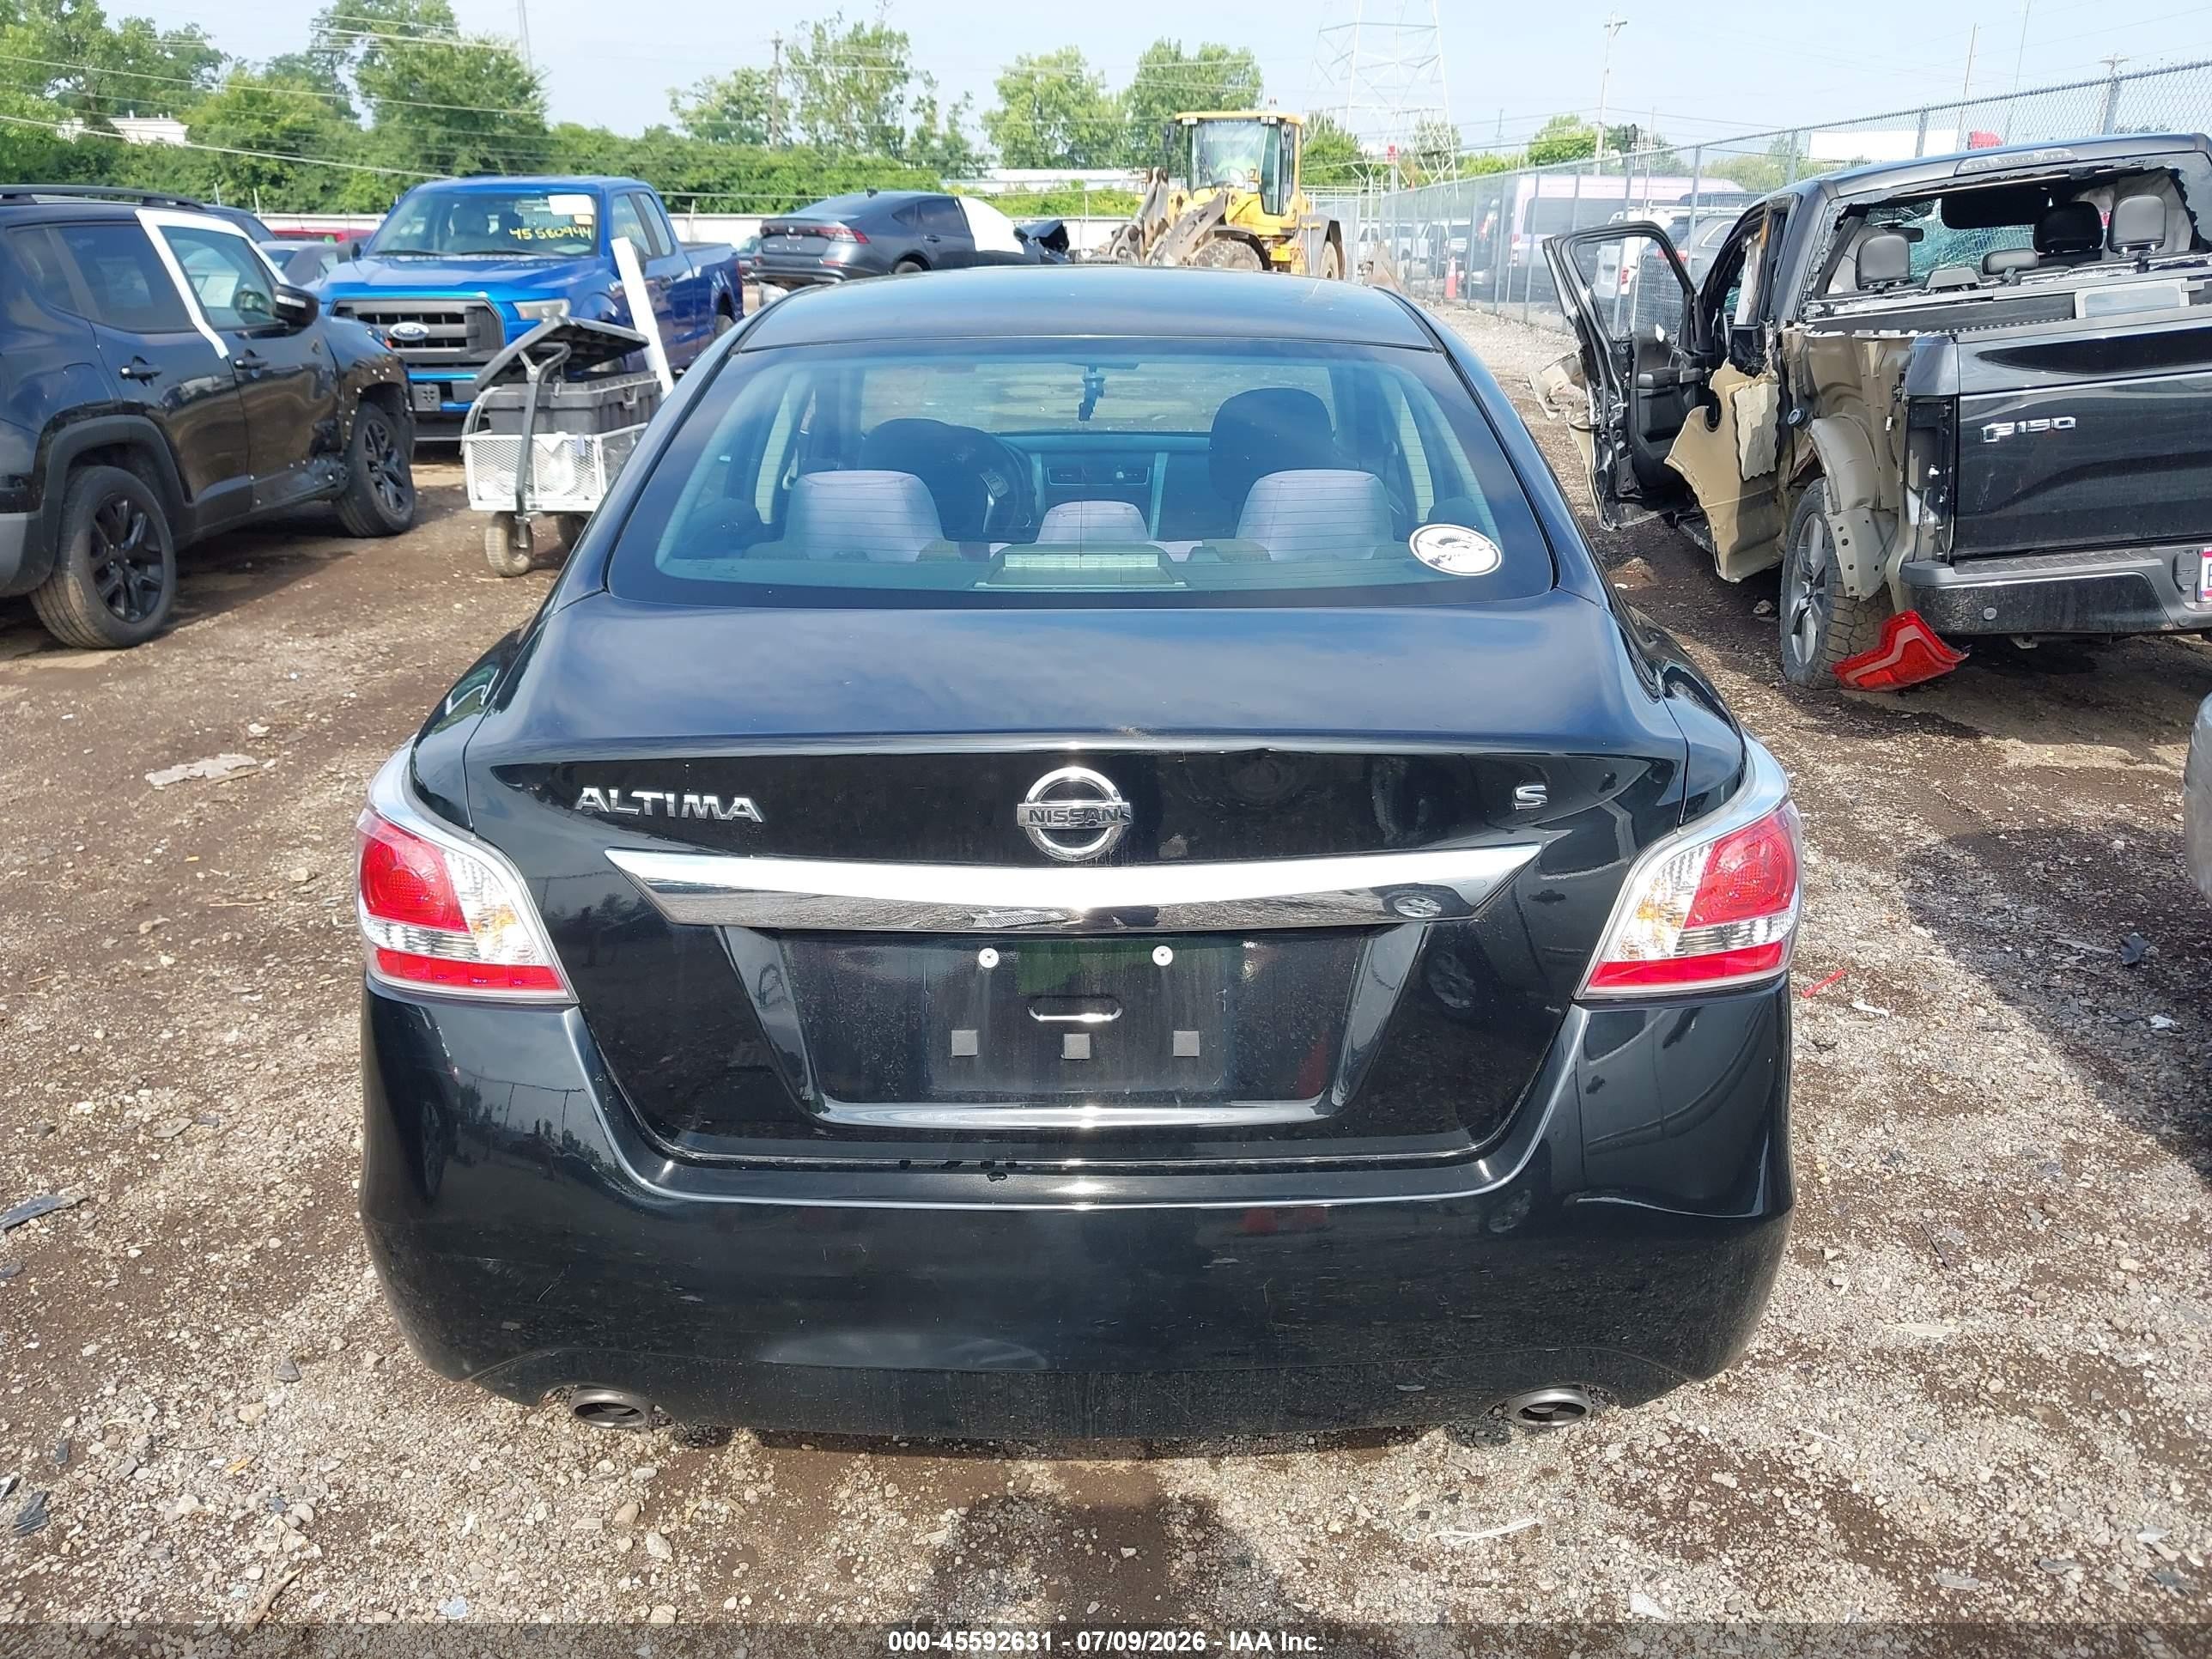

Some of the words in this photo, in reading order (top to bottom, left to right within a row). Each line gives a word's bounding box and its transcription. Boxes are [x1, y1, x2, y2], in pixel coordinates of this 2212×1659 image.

[574, 787, 763, 823] ALTIMA
[1514, 784, 1548, 811] S
[1029, 807, 1119, 823] NISSAN
